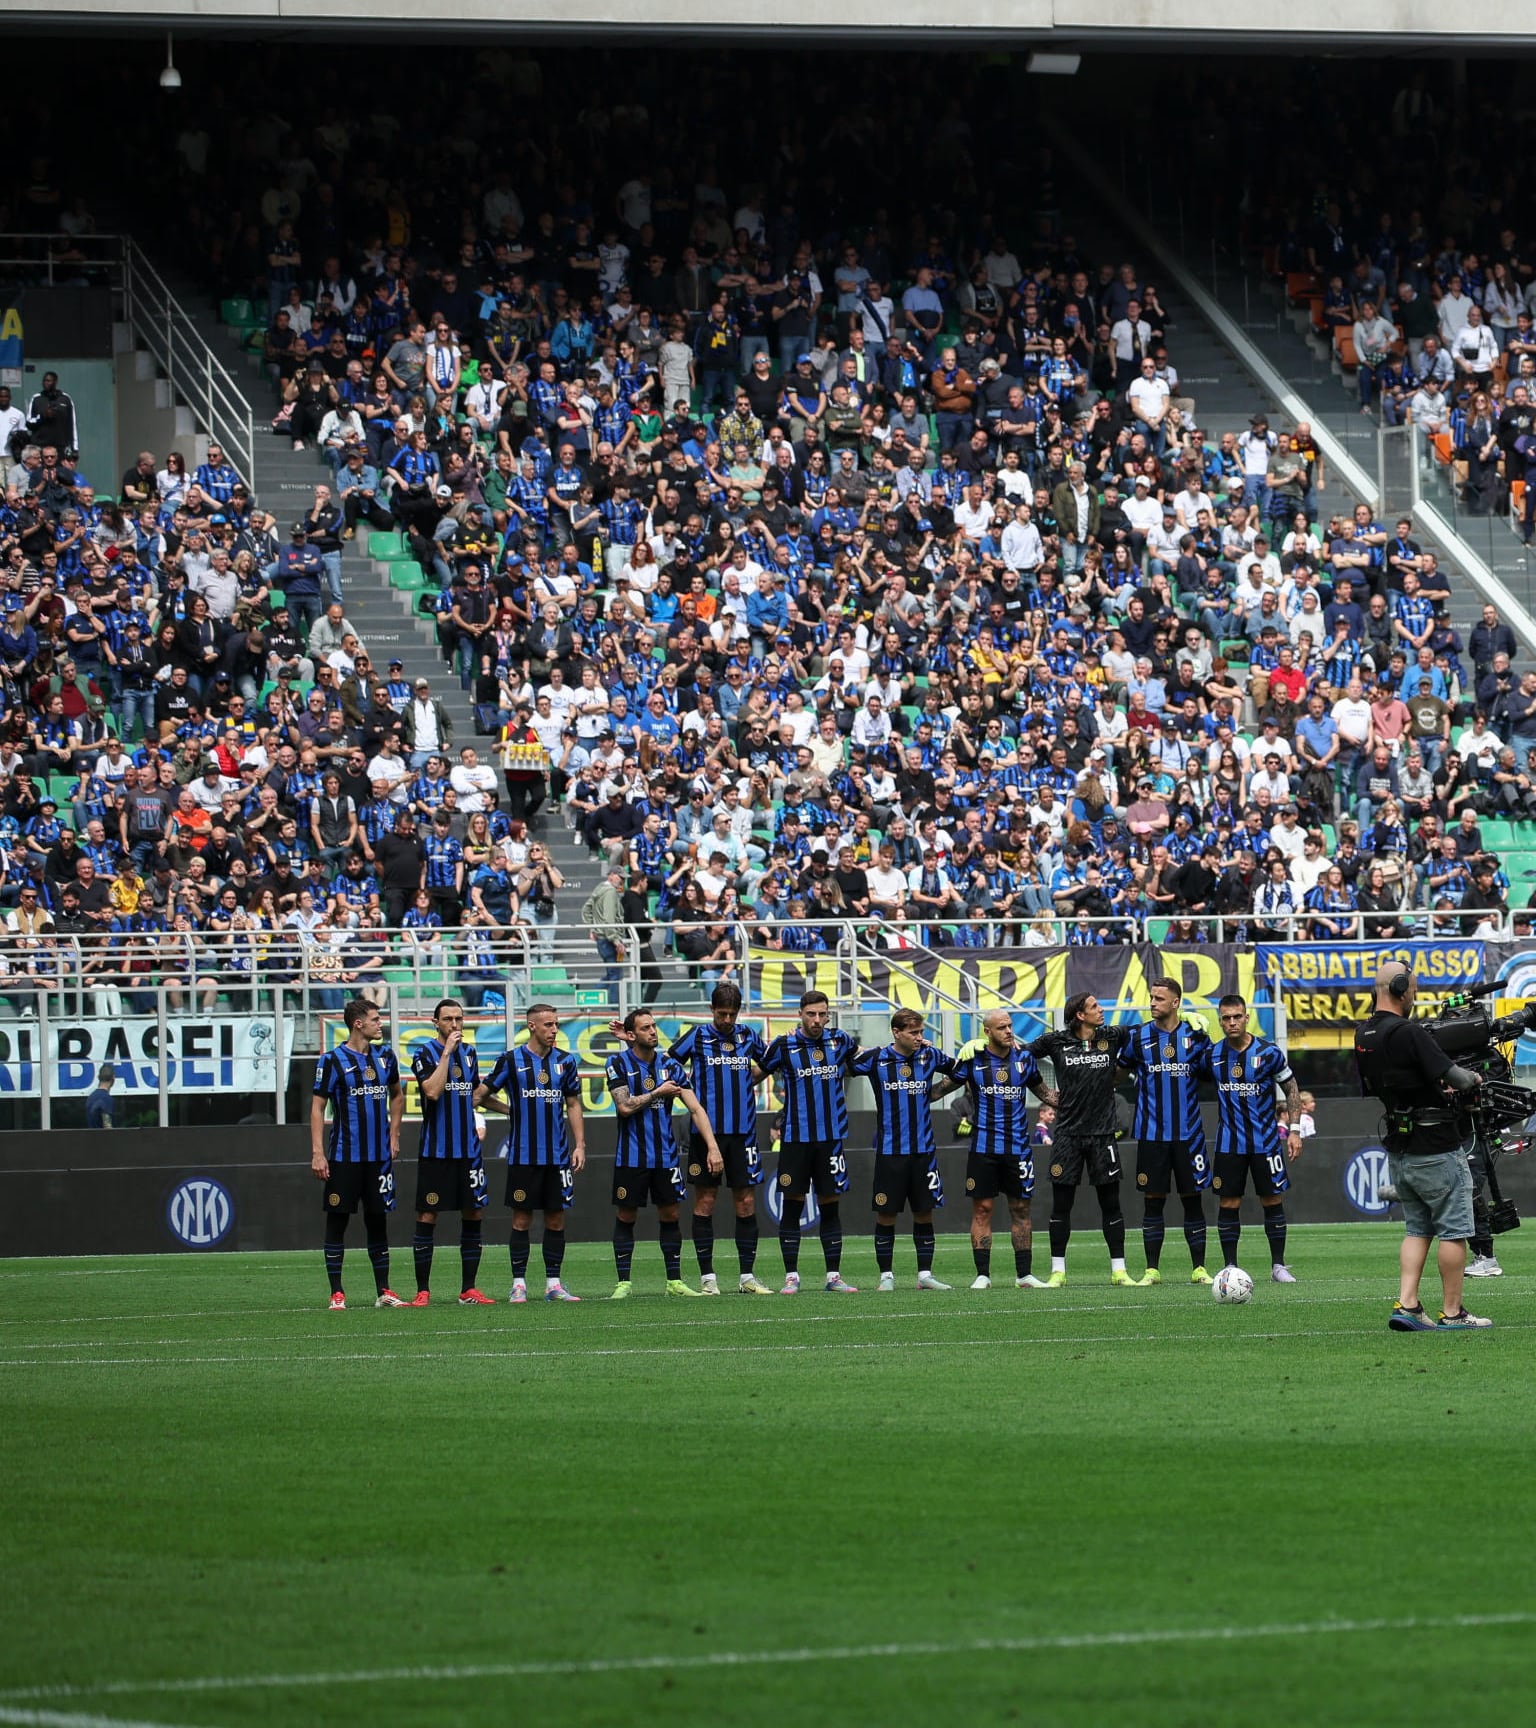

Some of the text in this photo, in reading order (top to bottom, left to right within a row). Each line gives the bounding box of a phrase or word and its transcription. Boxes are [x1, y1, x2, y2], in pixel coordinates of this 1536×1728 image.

[57, 1024, 234, 1091] BASEI
[707, 1055, 749, 1066] betsson
[1065, 1053, 1110, 1066] betsson
[1147, 1060, 1190, 1073] betsson
[797, 1064, 839, 1077] betsson
[445, 1080, 473, 1091] etsson
[522, 1087, 562, 1099] betsson
[883, 1079, 927, 1091] betsson
[979, 1084, 1022, 1096] betsson
[1219, 1081, 1260, 1092] betsson
[745, 1146, 759, 1166] 15
[1106, 1144, 1116, 1164] 1
[1193, 1153, 1205, 1173] 8
[829, 1155, 846, 1175] 30
[1018, 1160, 1035, 1180] 32
[1266, 1154, 1283, 1175] 10
[378, 1174, 393, 1194] 28
[469, 1168, 486, 1189] 36
[559, 1168, 574, 1188] 16
